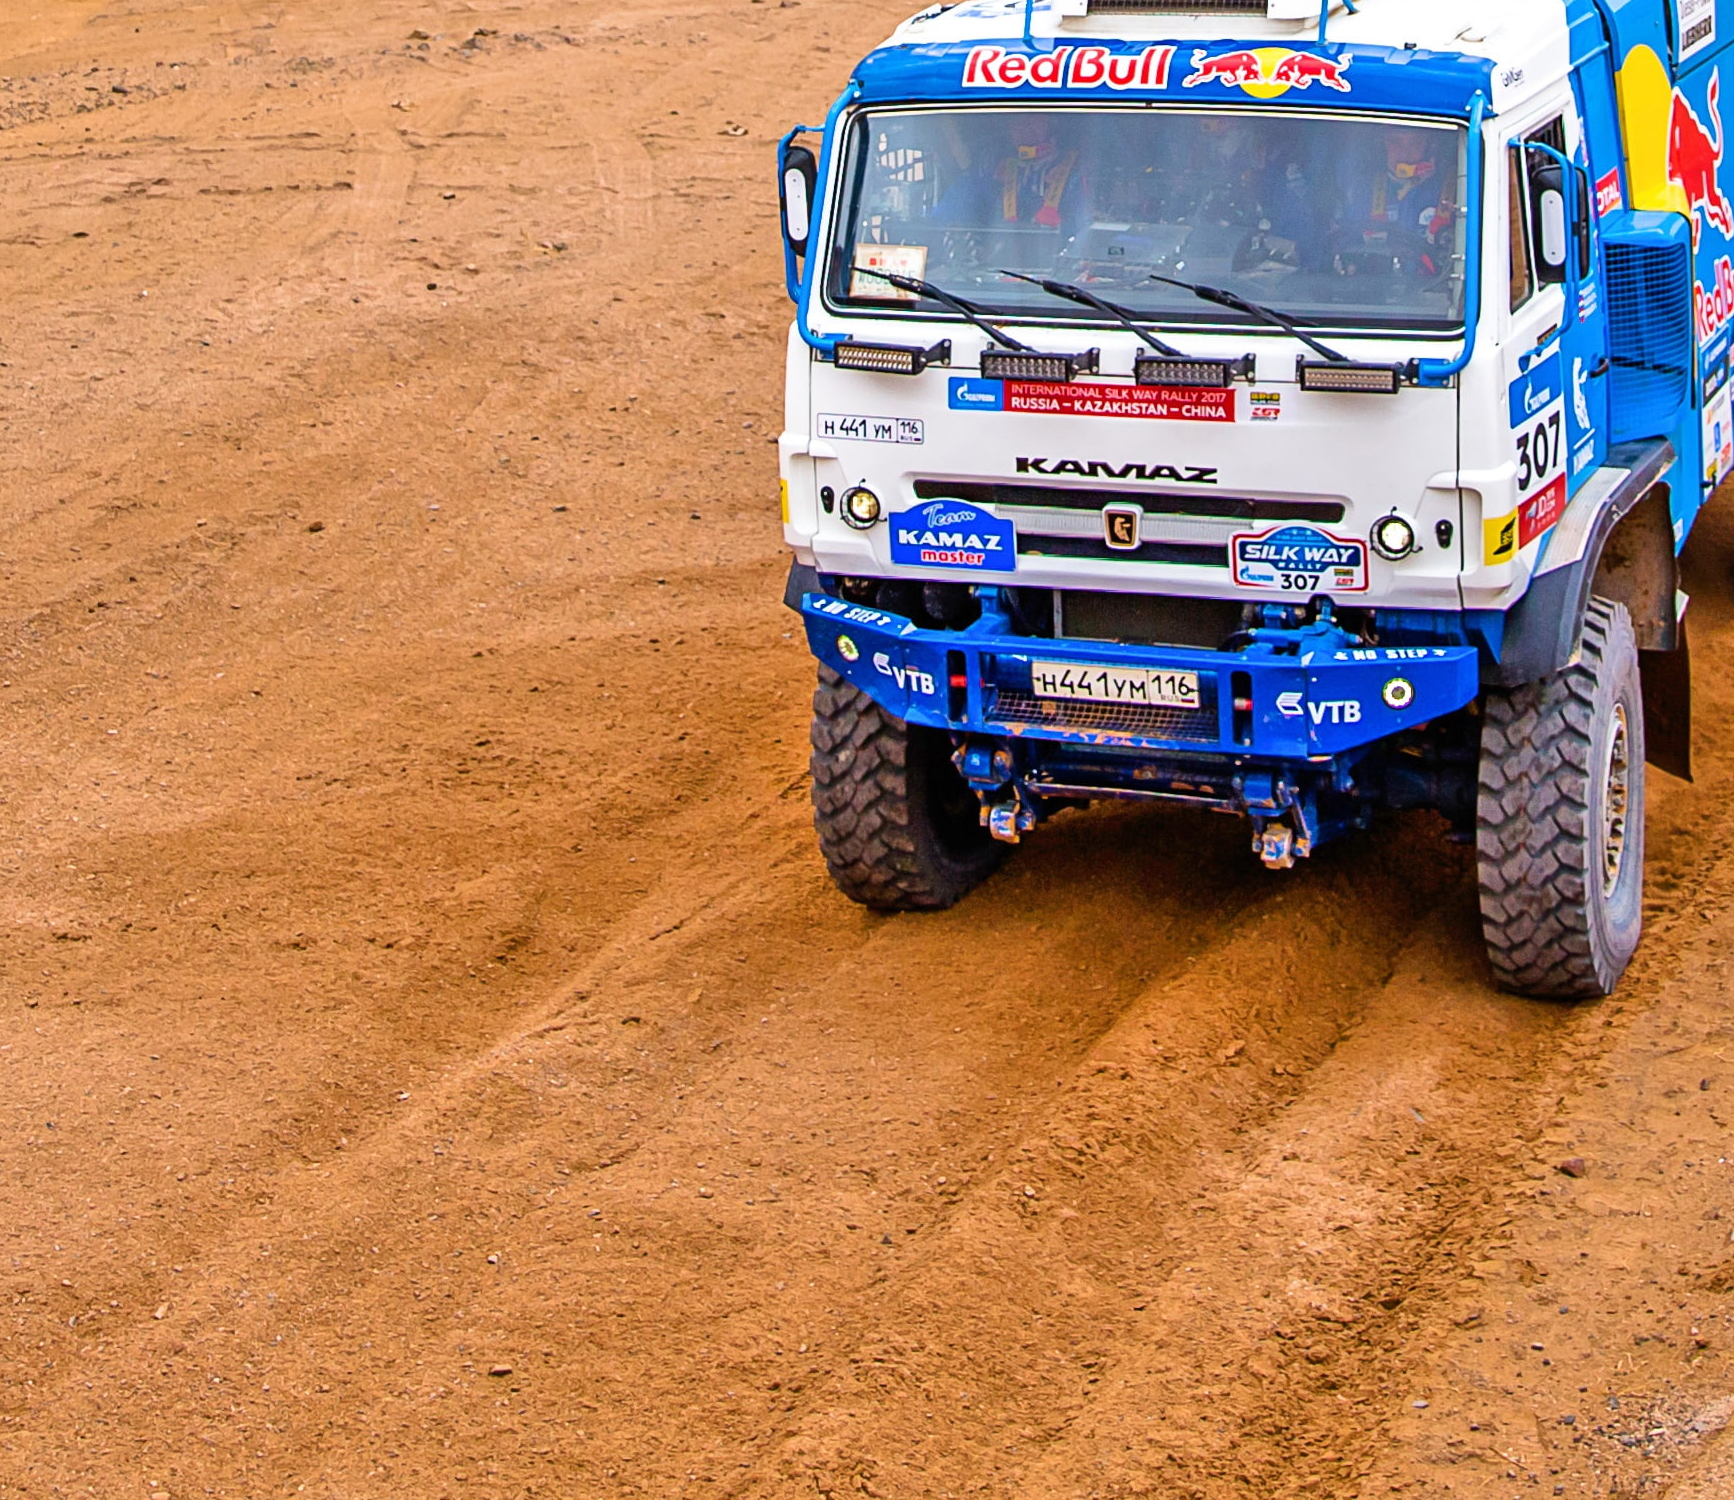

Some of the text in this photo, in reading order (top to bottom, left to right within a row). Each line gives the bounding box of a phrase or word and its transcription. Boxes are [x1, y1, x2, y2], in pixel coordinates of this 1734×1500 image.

[966, 48, 1174, 87] Red Bull
[1596, 181, 1620, 212] OTAL
[1695, 261, 1728, 345] Red
[1011, 384, 1227, 403] INTERNATIONAL SILK WAY RALLY 2017
[1011, 397, 1060, 411] RUSSIA
[1074, 400, 1167, 416] KAZAKHSTAN
[1182, 404, 1227, 417] CHINA
[839, 418, 867, 438] 441
[900, 421, 918, 434] 116
[1517, 410, 1560, 491] 307
[1016, 457, 1218, 484] KAMAZ
[923, 503, 976, 528] Team
[898, 529, 1003, 550] KAMAZ
[921, 550, 985, 565] master
[1244, 544, 1355, 563] SILK WAY
[1281, 573, 1320, 591] 307
[822, 601, 881, 624] NO STEP
[1352, 649, 1428, 660] NO STEP
[892, 666, 935, 695] VTB
[1151, 674, 1190, 696] 116
[1307, 700, 1361, 724] VTB
